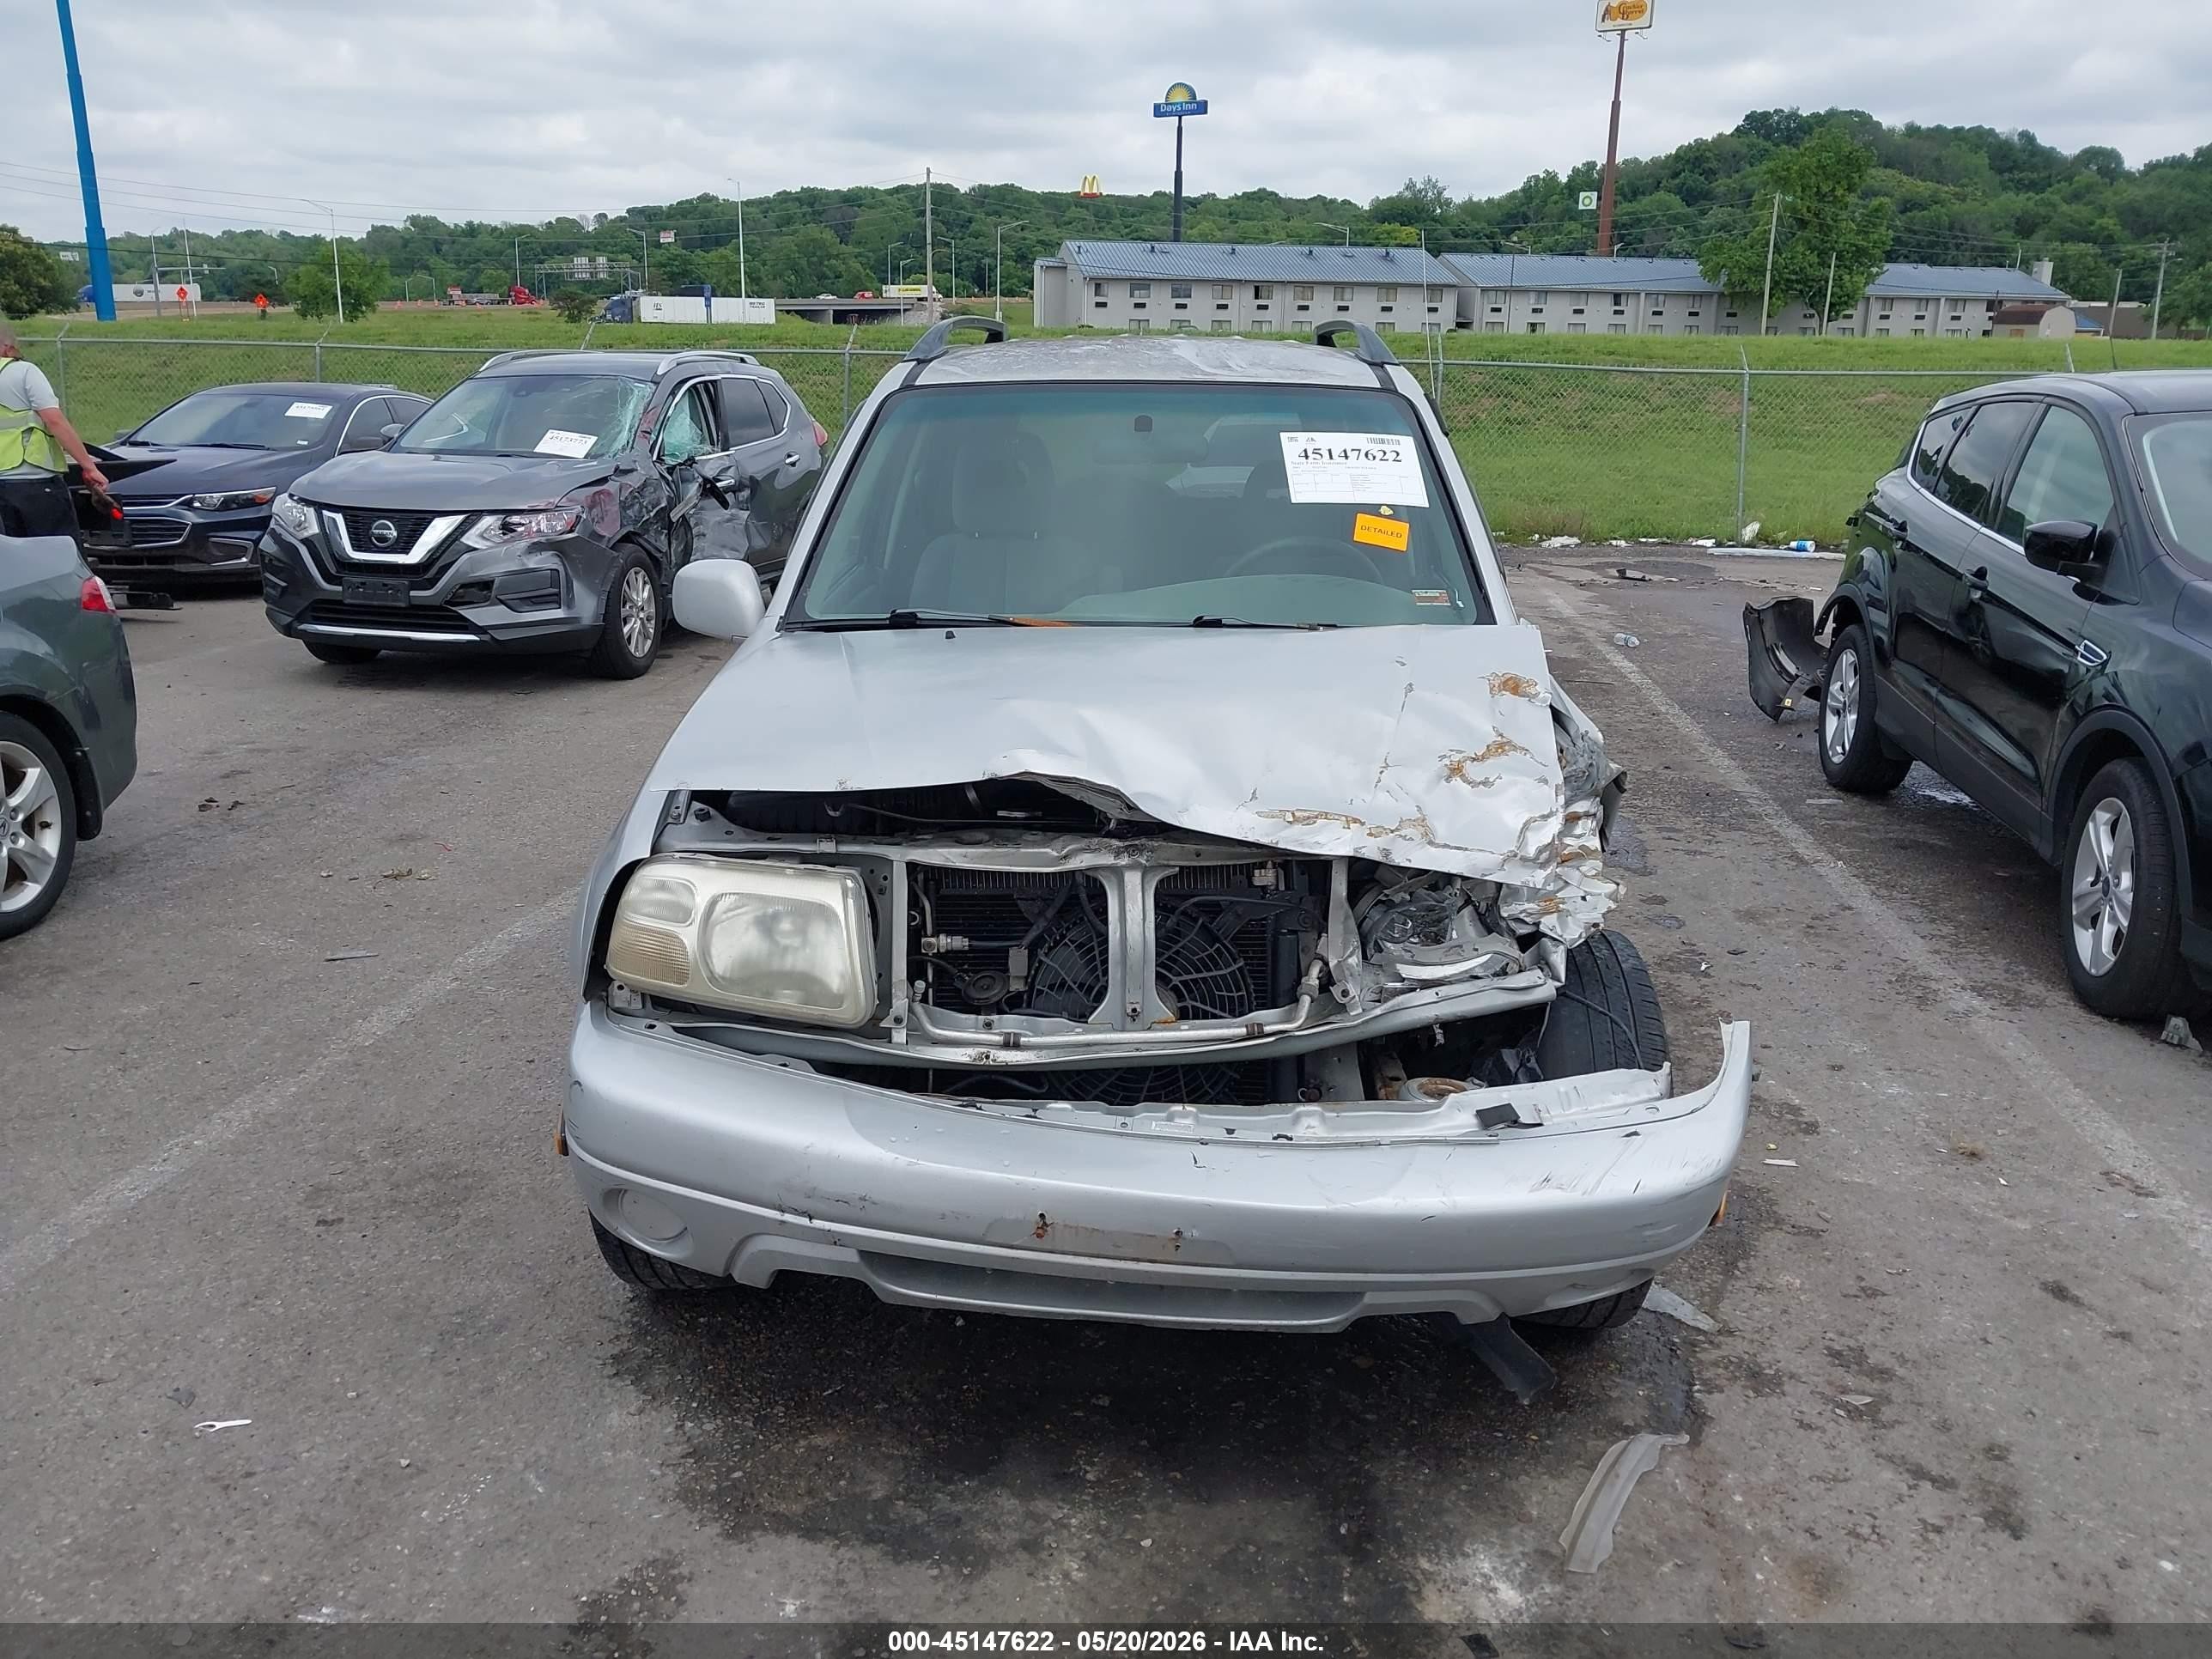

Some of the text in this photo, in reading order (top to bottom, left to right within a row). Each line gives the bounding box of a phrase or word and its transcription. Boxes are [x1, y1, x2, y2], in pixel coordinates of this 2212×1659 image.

[1160, 102, 1198, 112] Days Inn
[1297, 447, 1402, 463] 45147622
[1360, 525, 1403, 538] DETAILED
